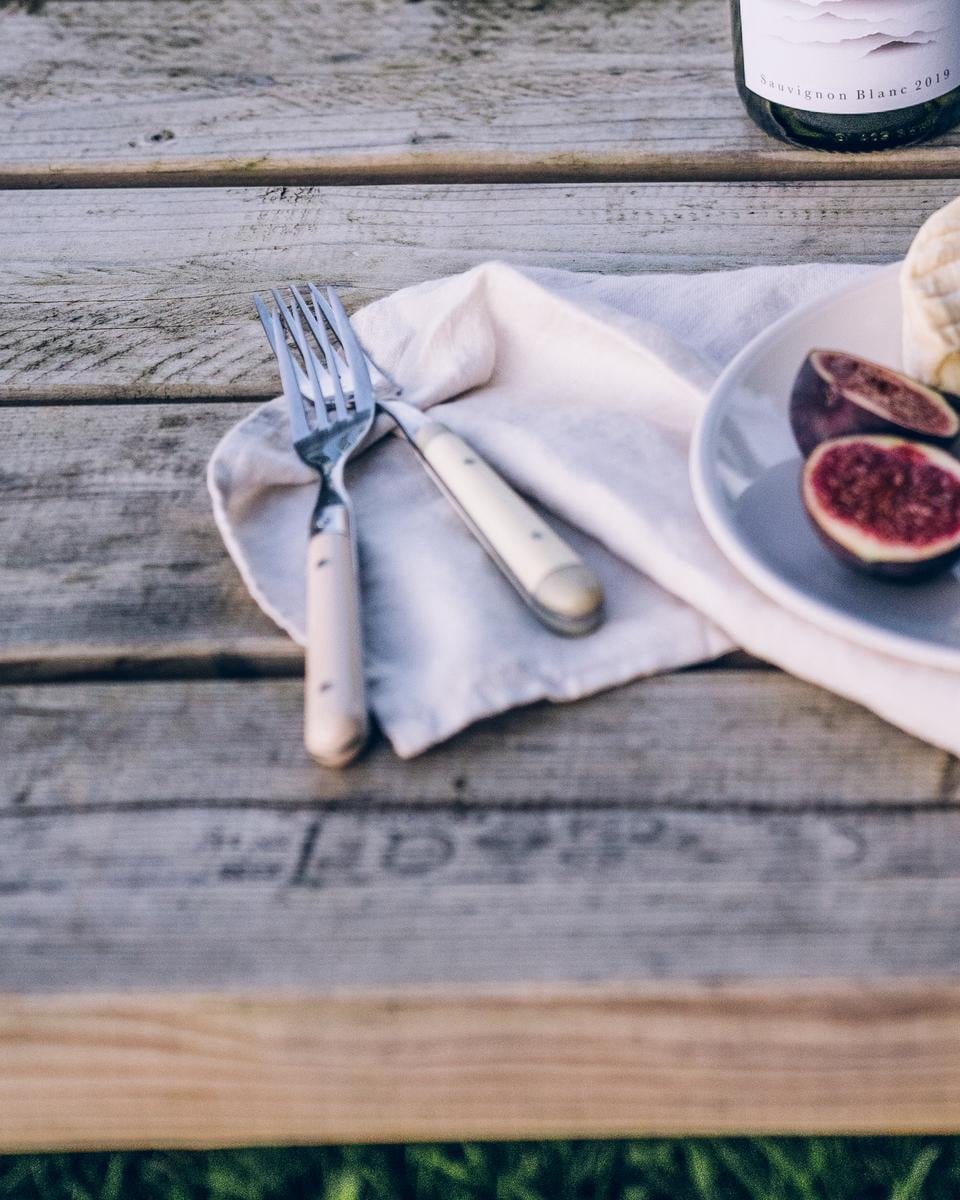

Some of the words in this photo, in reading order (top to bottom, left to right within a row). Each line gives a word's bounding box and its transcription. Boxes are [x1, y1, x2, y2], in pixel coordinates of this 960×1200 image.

[760, 73, 847, 101] Sauvignon
[856, 85, 907, 101] Blanc
[914, 68, 951, 92] 2019
